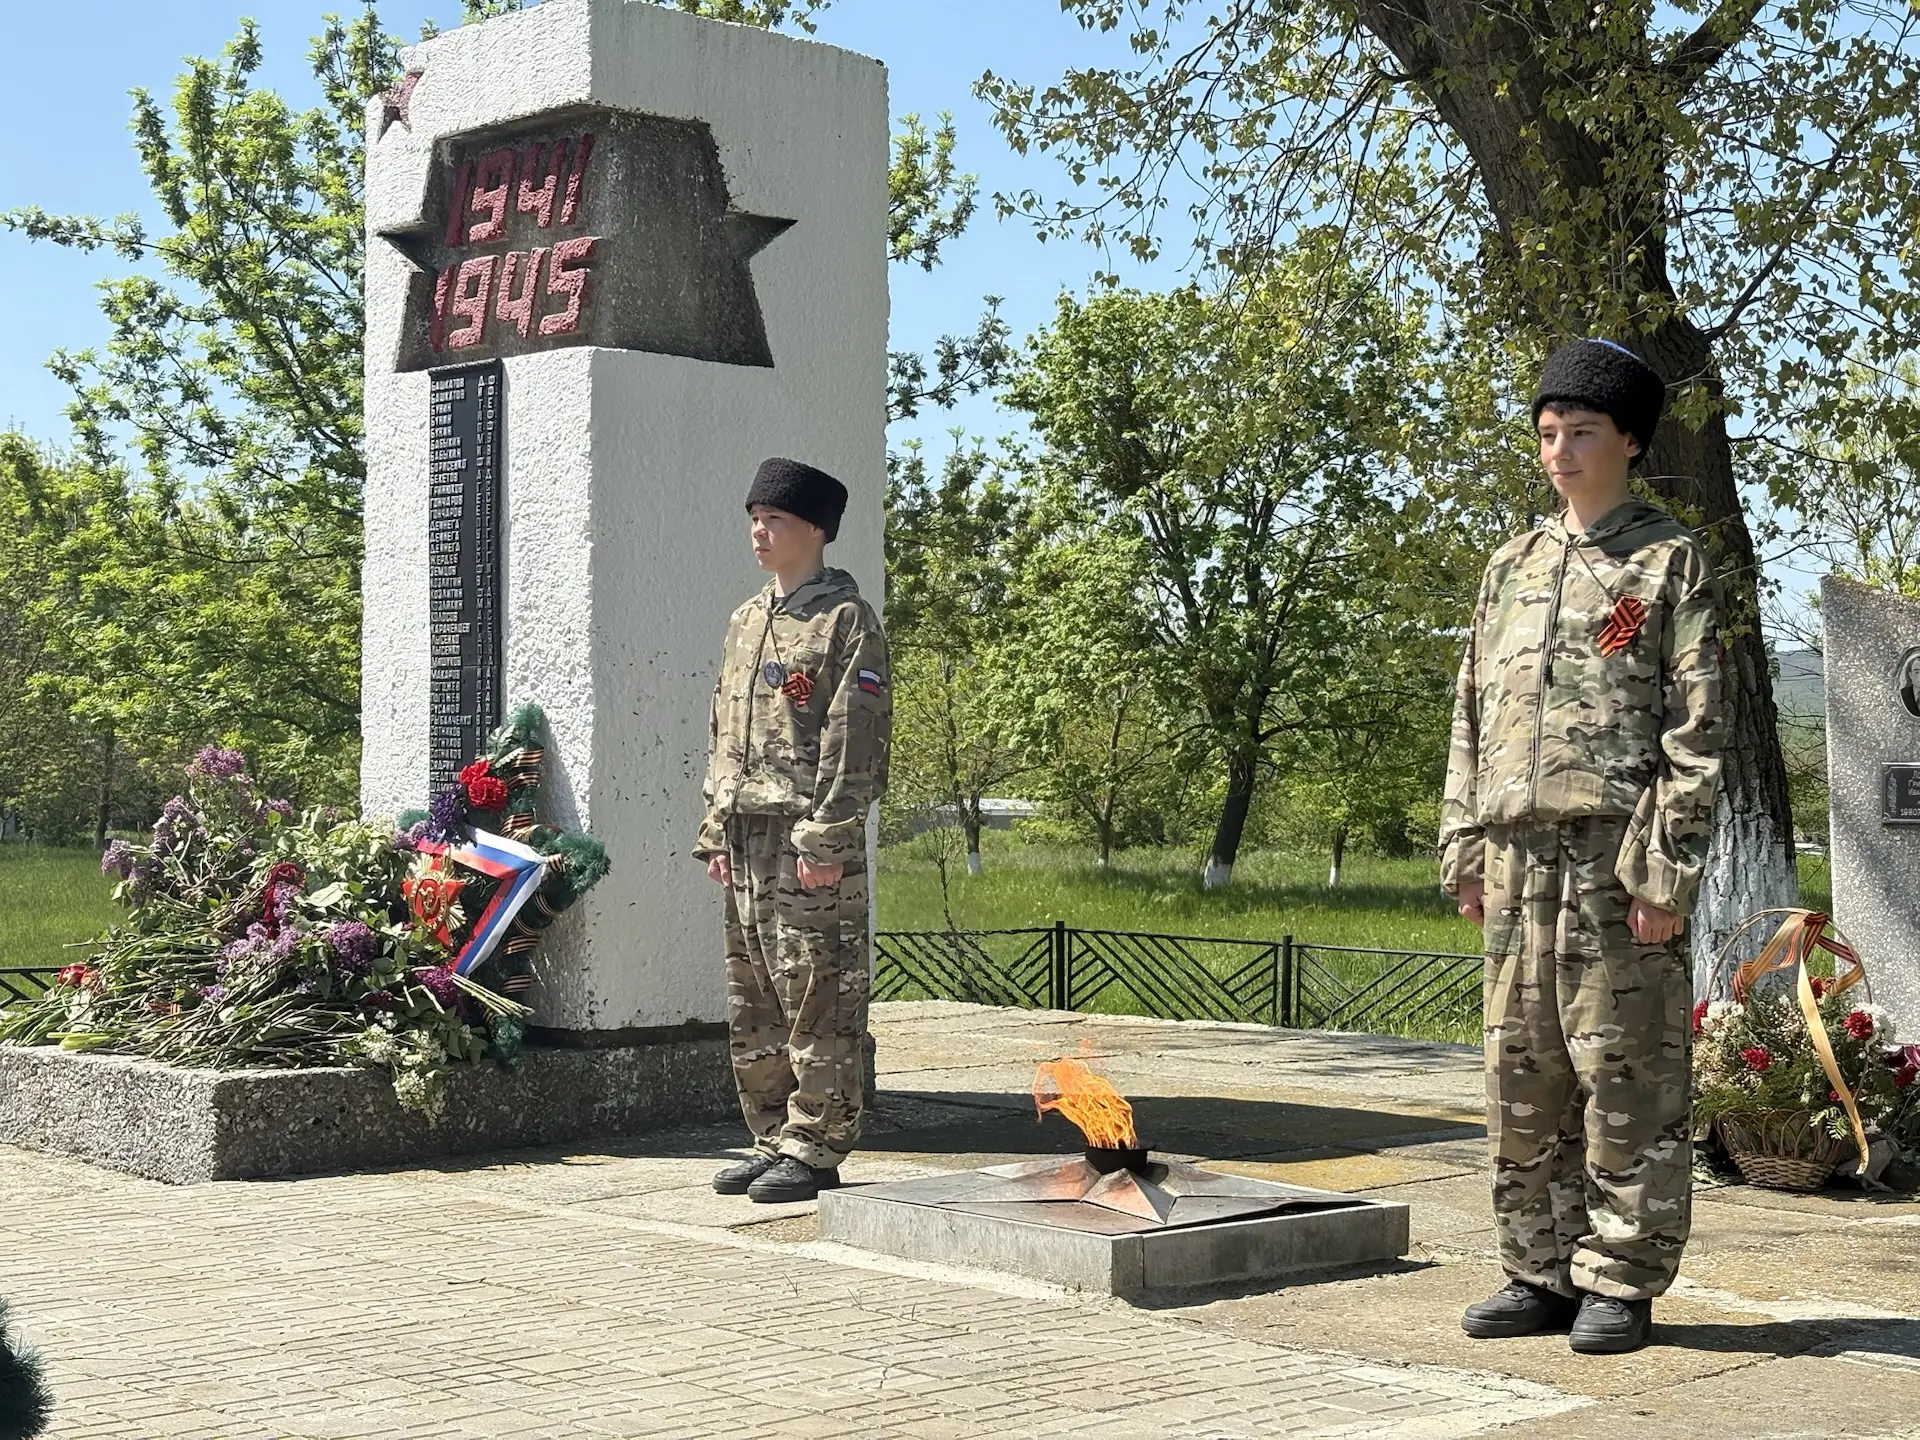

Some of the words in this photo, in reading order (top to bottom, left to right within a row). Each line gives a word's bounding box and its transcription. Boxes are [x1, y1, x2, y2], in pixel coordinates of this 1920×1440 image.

[446, 133, 596, 248] 1941
[430, 236, 603, 353] 1945
[431, 377, 465, 392] БАШКАТОВ
[431, 389, 465, 404] БАШКАТОВ
[430, 437, 462, 451] БАБЫКИН
[430, 448, 461, 462] БАБЫКИН
[430, 458, 468, 473] БОРИСЕНКО
[430, 472, 459, 485] БЕКЕТОВ
[430, 495, 463, 509] ГОНЧАРОВ
[430, 507, 463, 520] ГОНЧАРОВ
[430, 553, 459, 565] ЖЕРДЕВ
[431, 669, 461, 680] МАКАРОВ
[430, 704, 460, 714] РУСАНОВ
[430, 715, 472, 725] РЫБАЛЧЕНКО
[430, 726, 461, 737] СОТНИКОВ
